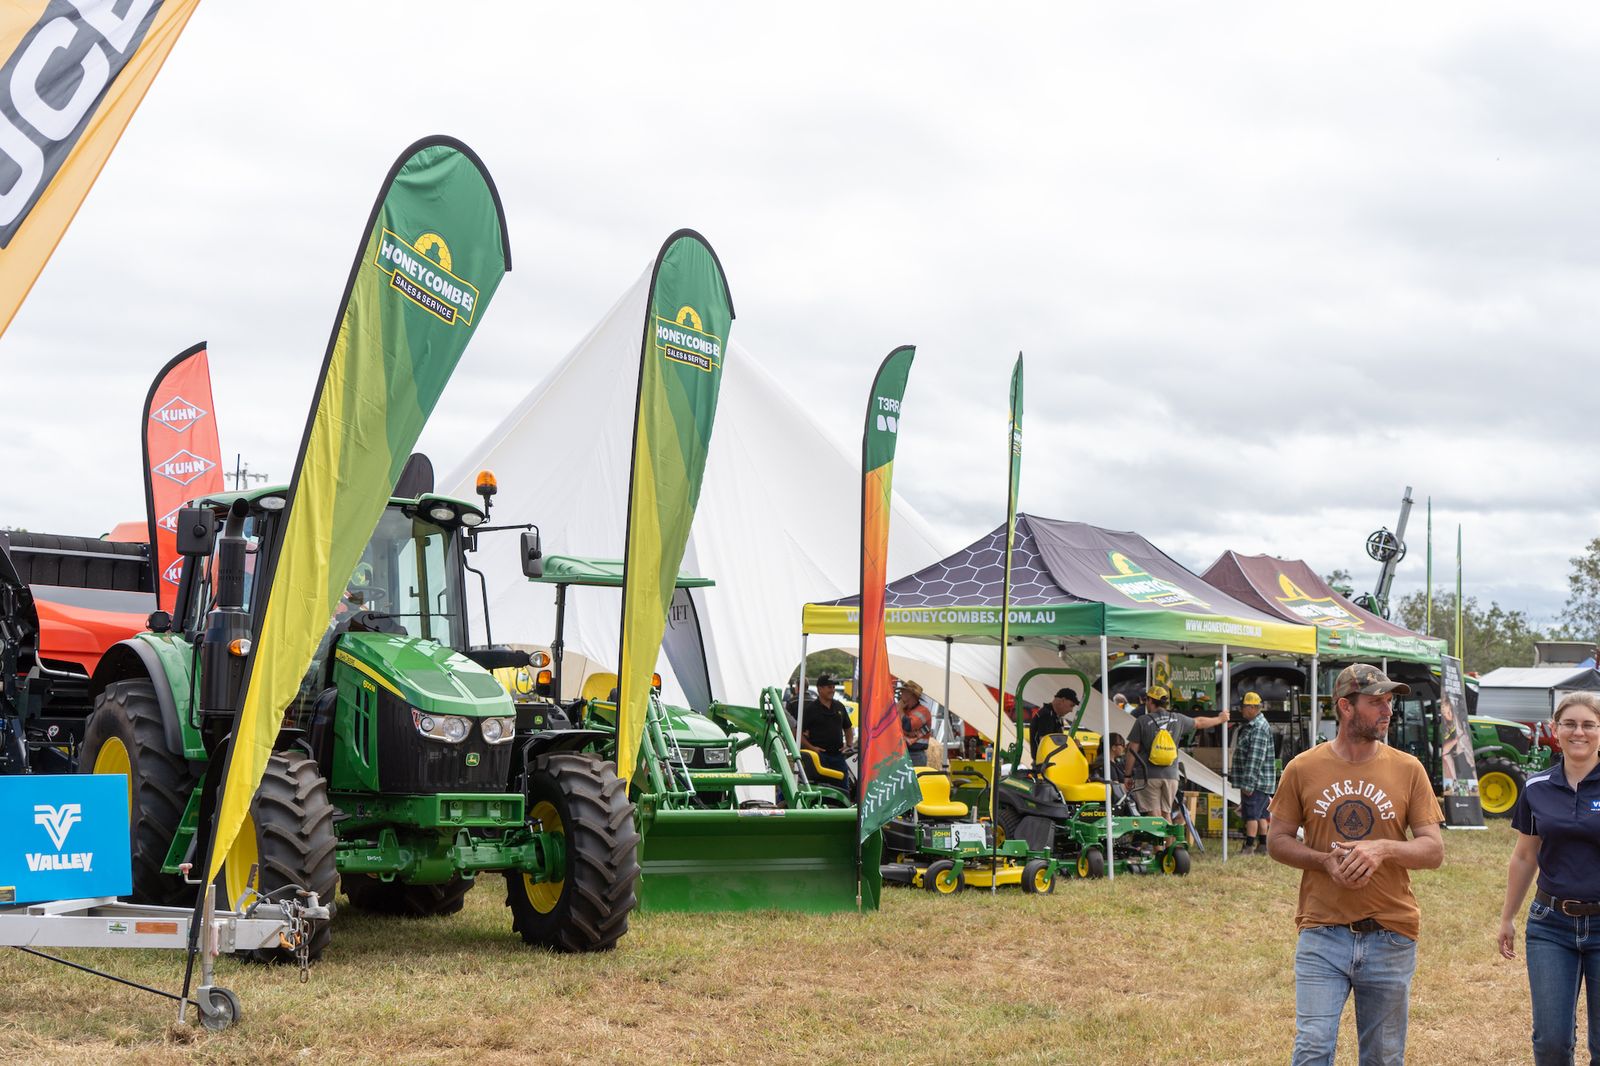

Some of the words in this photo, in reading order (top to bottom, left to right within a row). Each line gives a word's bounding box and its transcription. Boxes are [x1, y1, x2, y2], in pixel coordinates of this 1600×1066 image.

[381, 240, 475, 312] HONEYCOMBES
[395, 275, 417, 297] SALES
[416, 291, 422, 300] &
[421, 294, 453, 320] SERVICE
[656, 325, 720, 358] HONEYCOMBE
[667, 348, 684, 359] SALES
[877, 396, 901, 414] T3RR
[161, 407, 197, 422] KUHN
[164, 460, 206, 475] KUHN
[669, 604, 689, 621] IFT
[846, 610, 1056, 625] W.HONEYCOMBES.OM.AU
[1171, 667, 1184, 681] John
[1183, 667, 1200, 681] Deere
[1200, 666, 1215, 681] TOYS
[25, 852, 93, 872] VALLEY
